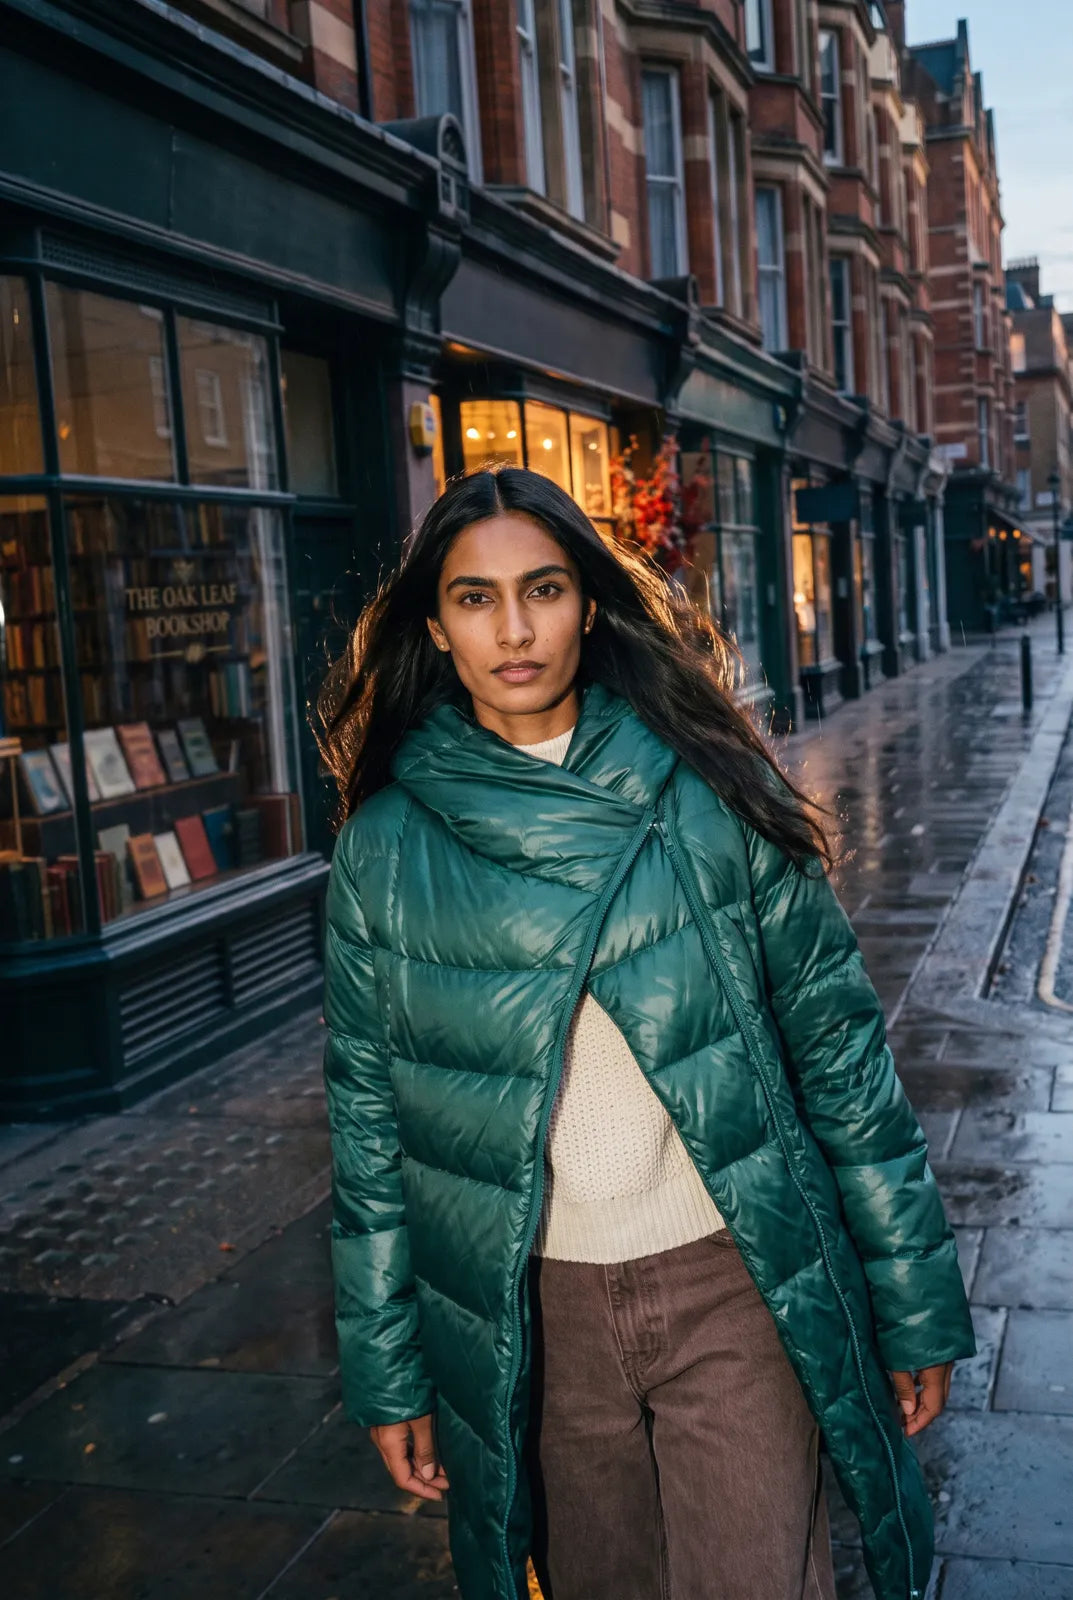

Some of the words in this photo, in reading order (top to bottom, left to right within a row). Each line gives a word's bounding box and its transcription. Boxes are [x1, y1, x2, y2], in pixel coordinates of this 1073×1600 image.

[125, 587, 160, 611] THE
[162, 585, 198, 608] OAK
[201, 584, 236, 606] LEAF
[146, 611, 230, 639] BOOKSHOP
